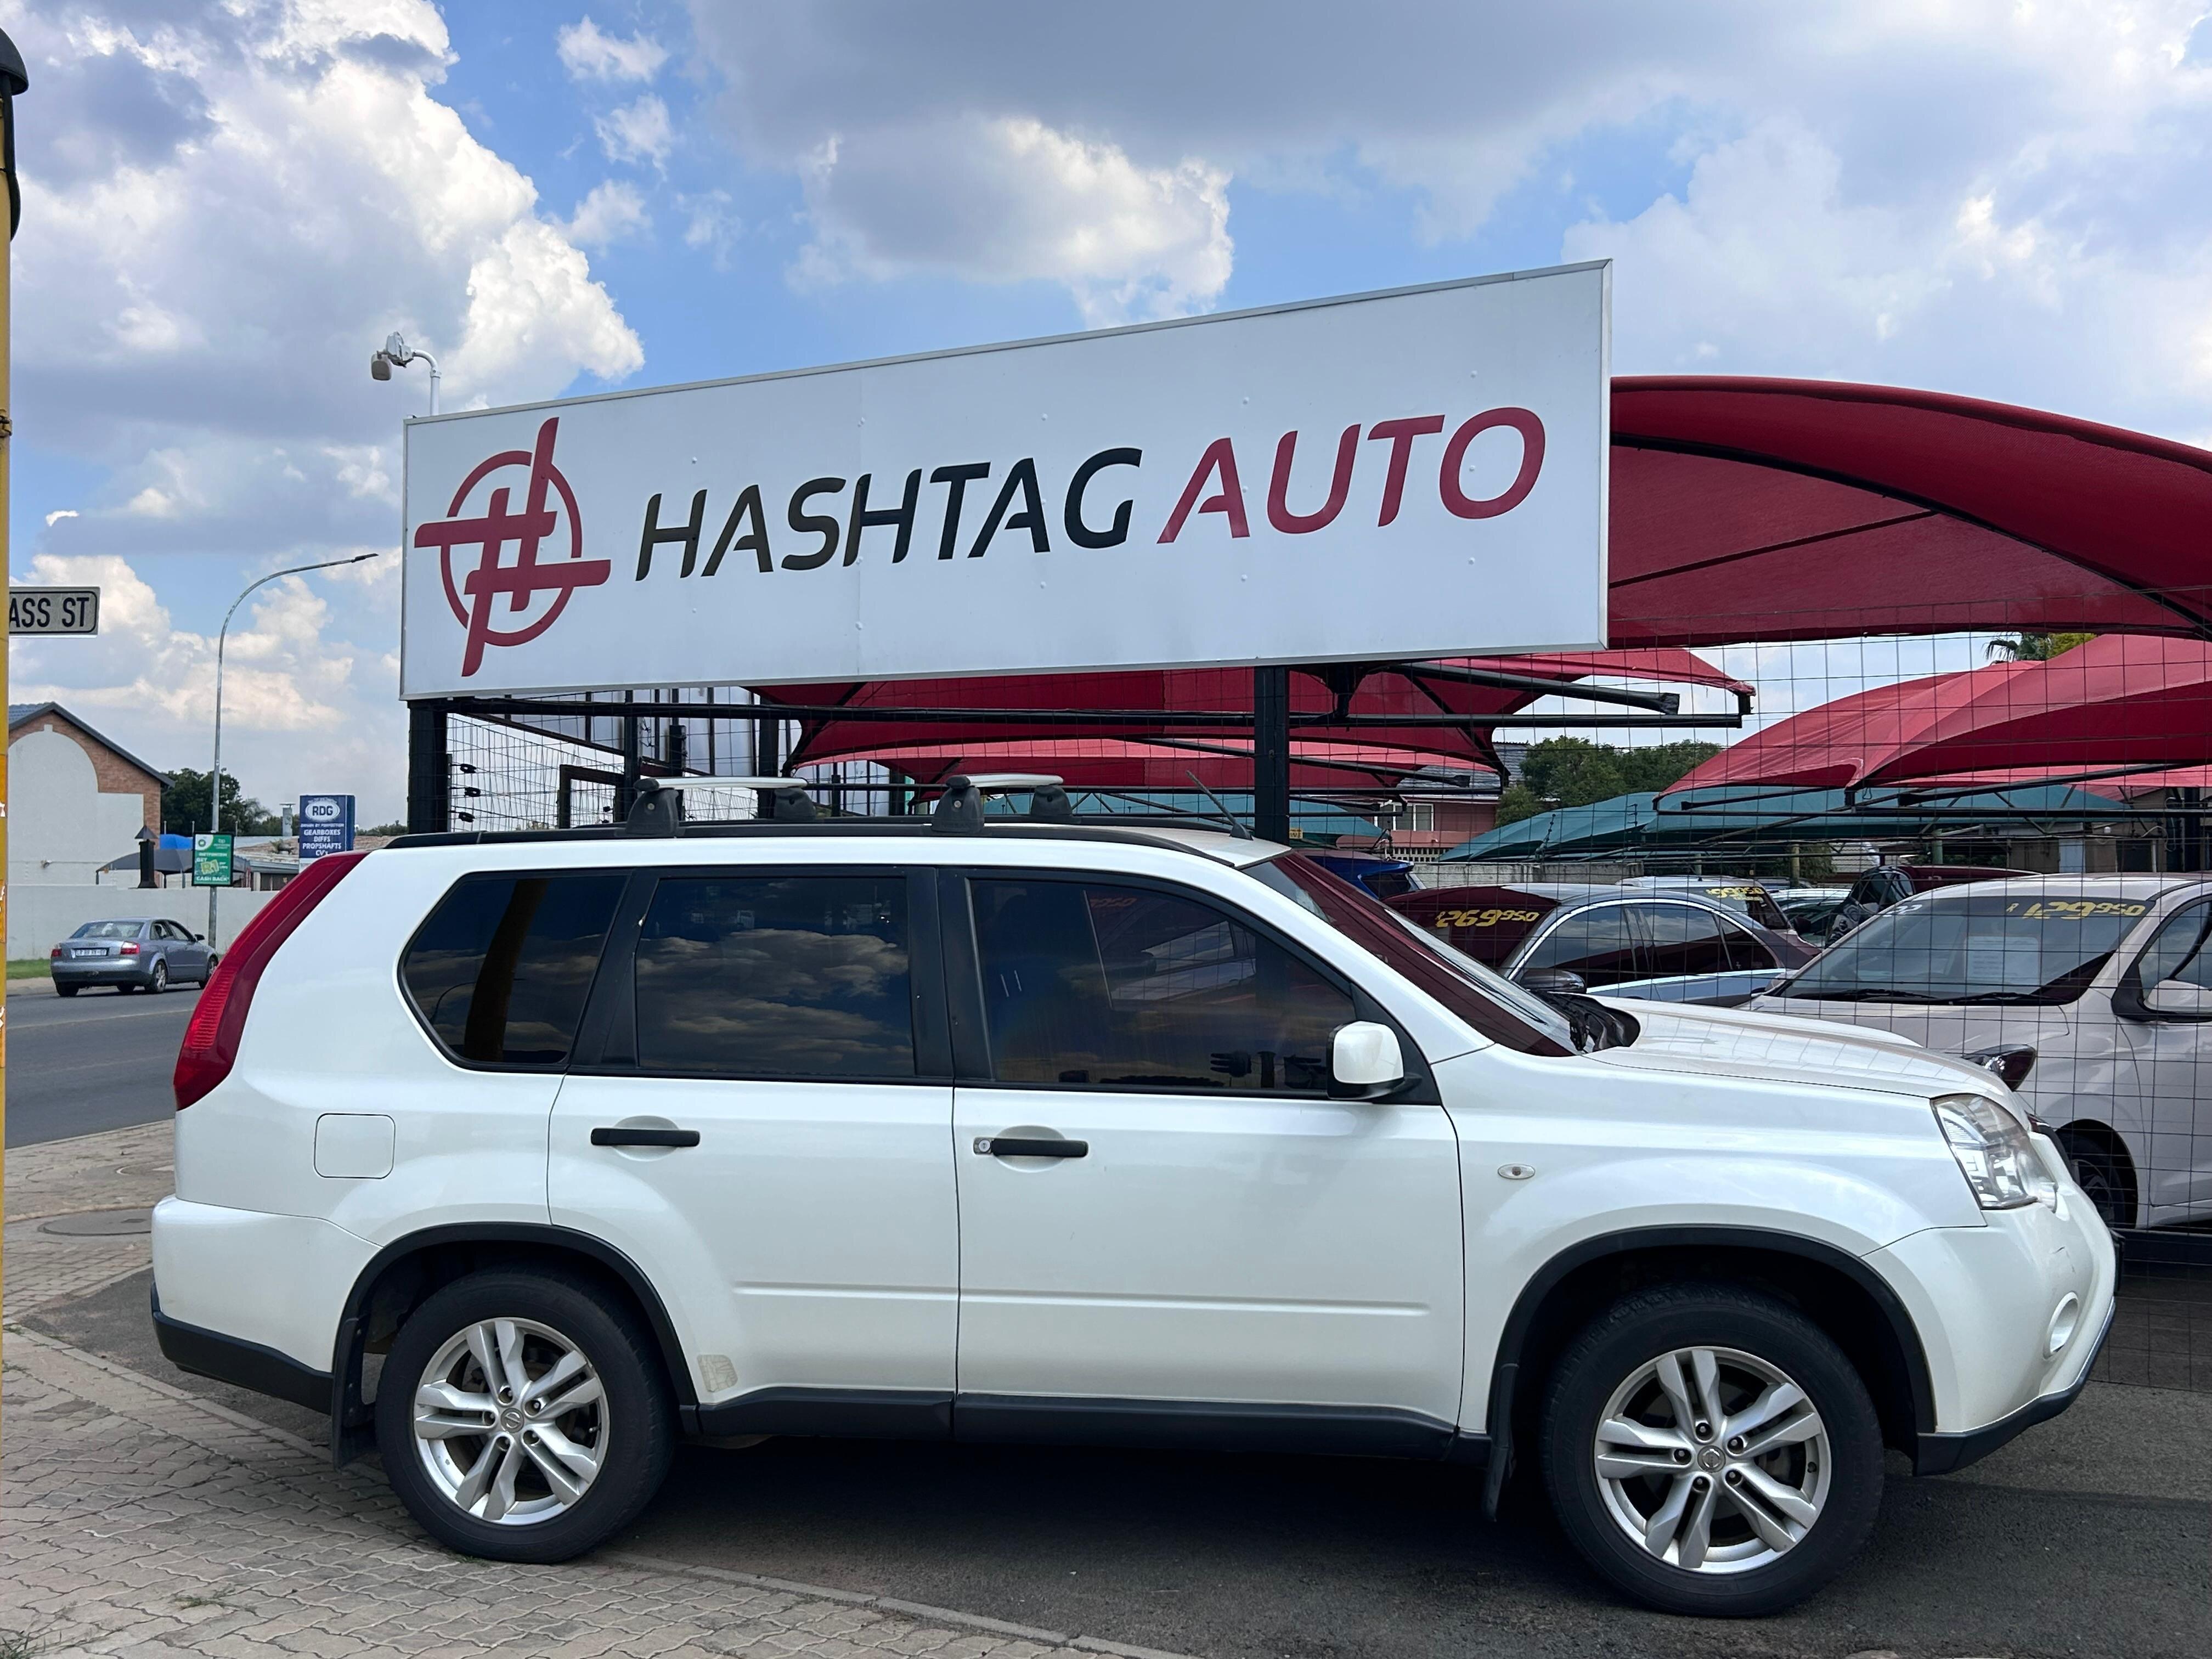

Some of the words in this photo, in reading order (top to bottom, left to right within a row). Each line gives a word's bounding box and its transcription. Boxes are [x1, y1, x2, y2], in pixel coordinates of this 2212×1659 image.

[636, 448, 1142, 582] HASHTAG
[1159, 408, 1544, 542] AUTO
[9, 597, 50, 628] ASS
[62, 597, 89, 627] ST
[312, 805, 333, 816] RDG
